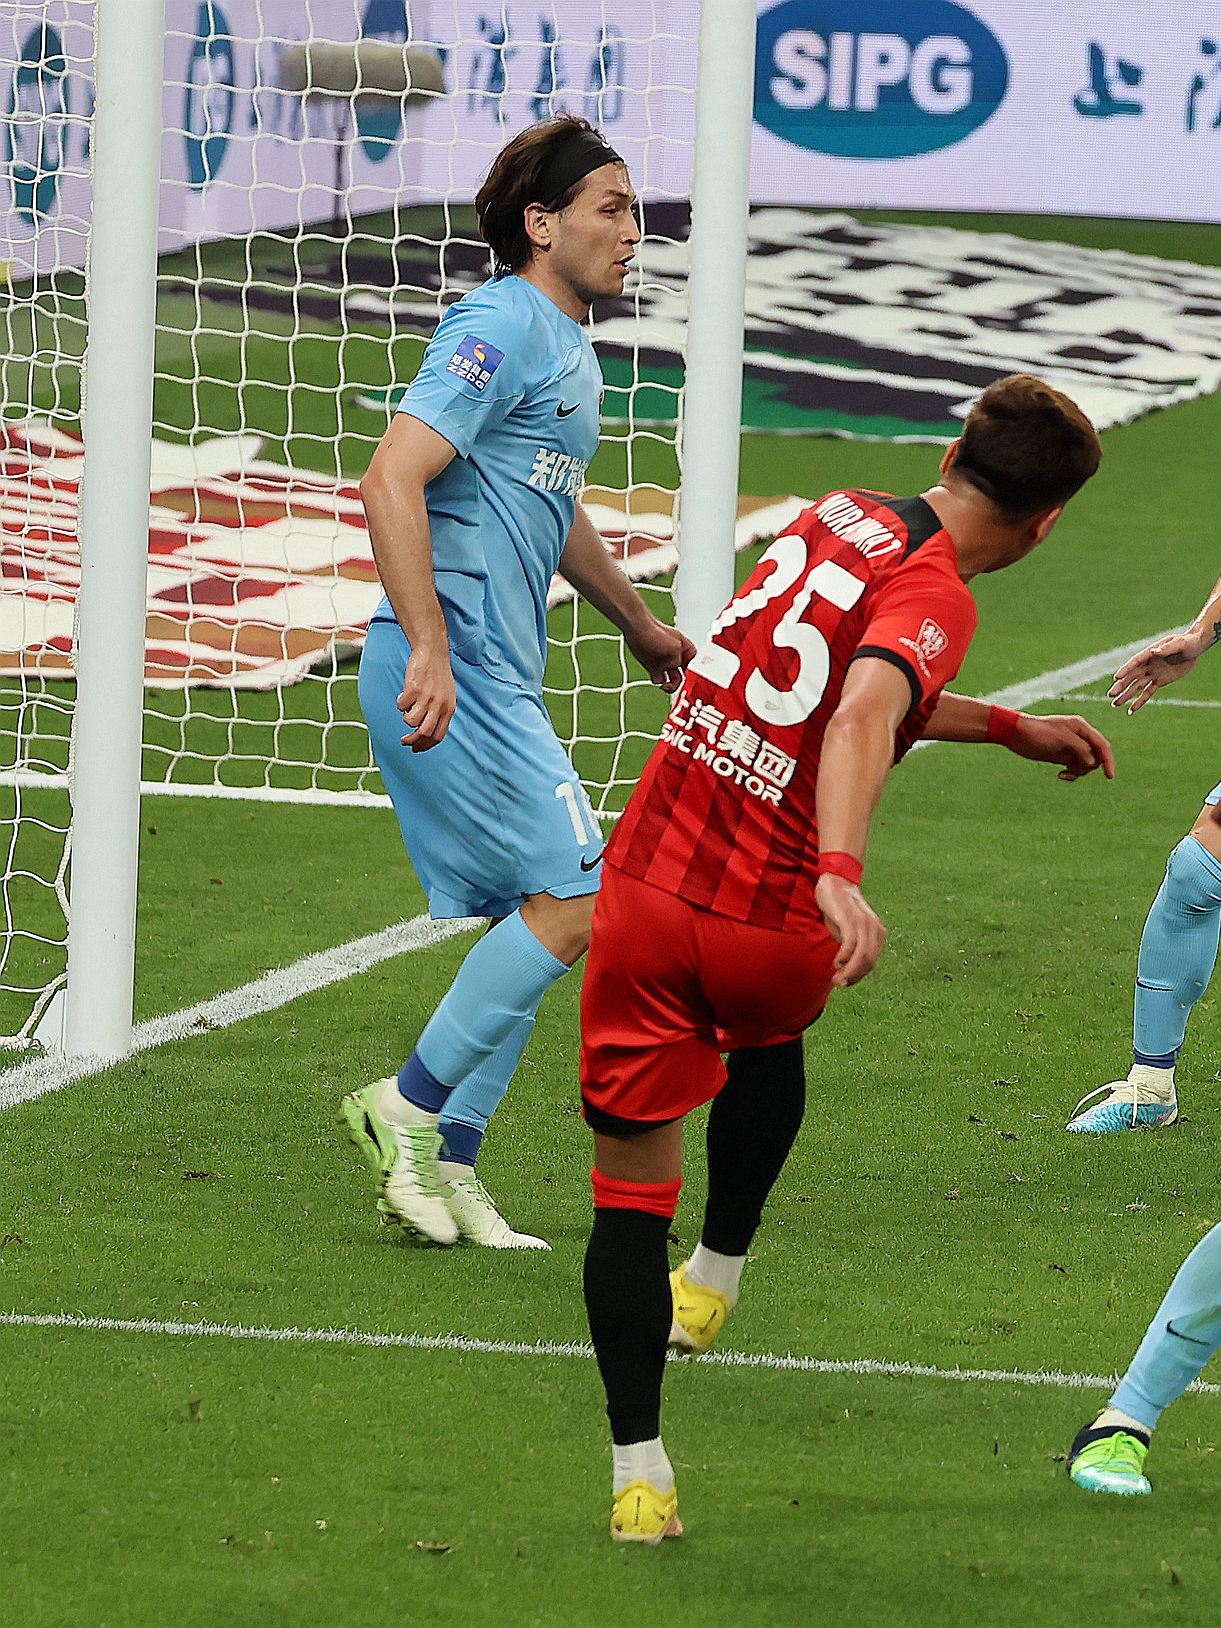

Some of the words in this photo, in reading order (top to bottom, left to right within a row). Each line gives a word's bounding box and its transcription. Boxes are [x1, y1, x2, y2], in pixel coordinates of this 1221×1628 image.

[769, 27, 974, 115] SIPG
[687, 535, 867, 727] 25
[668, 690, 798, 788] 上汽集团
[692, 742, 784, 807] MOTOR
